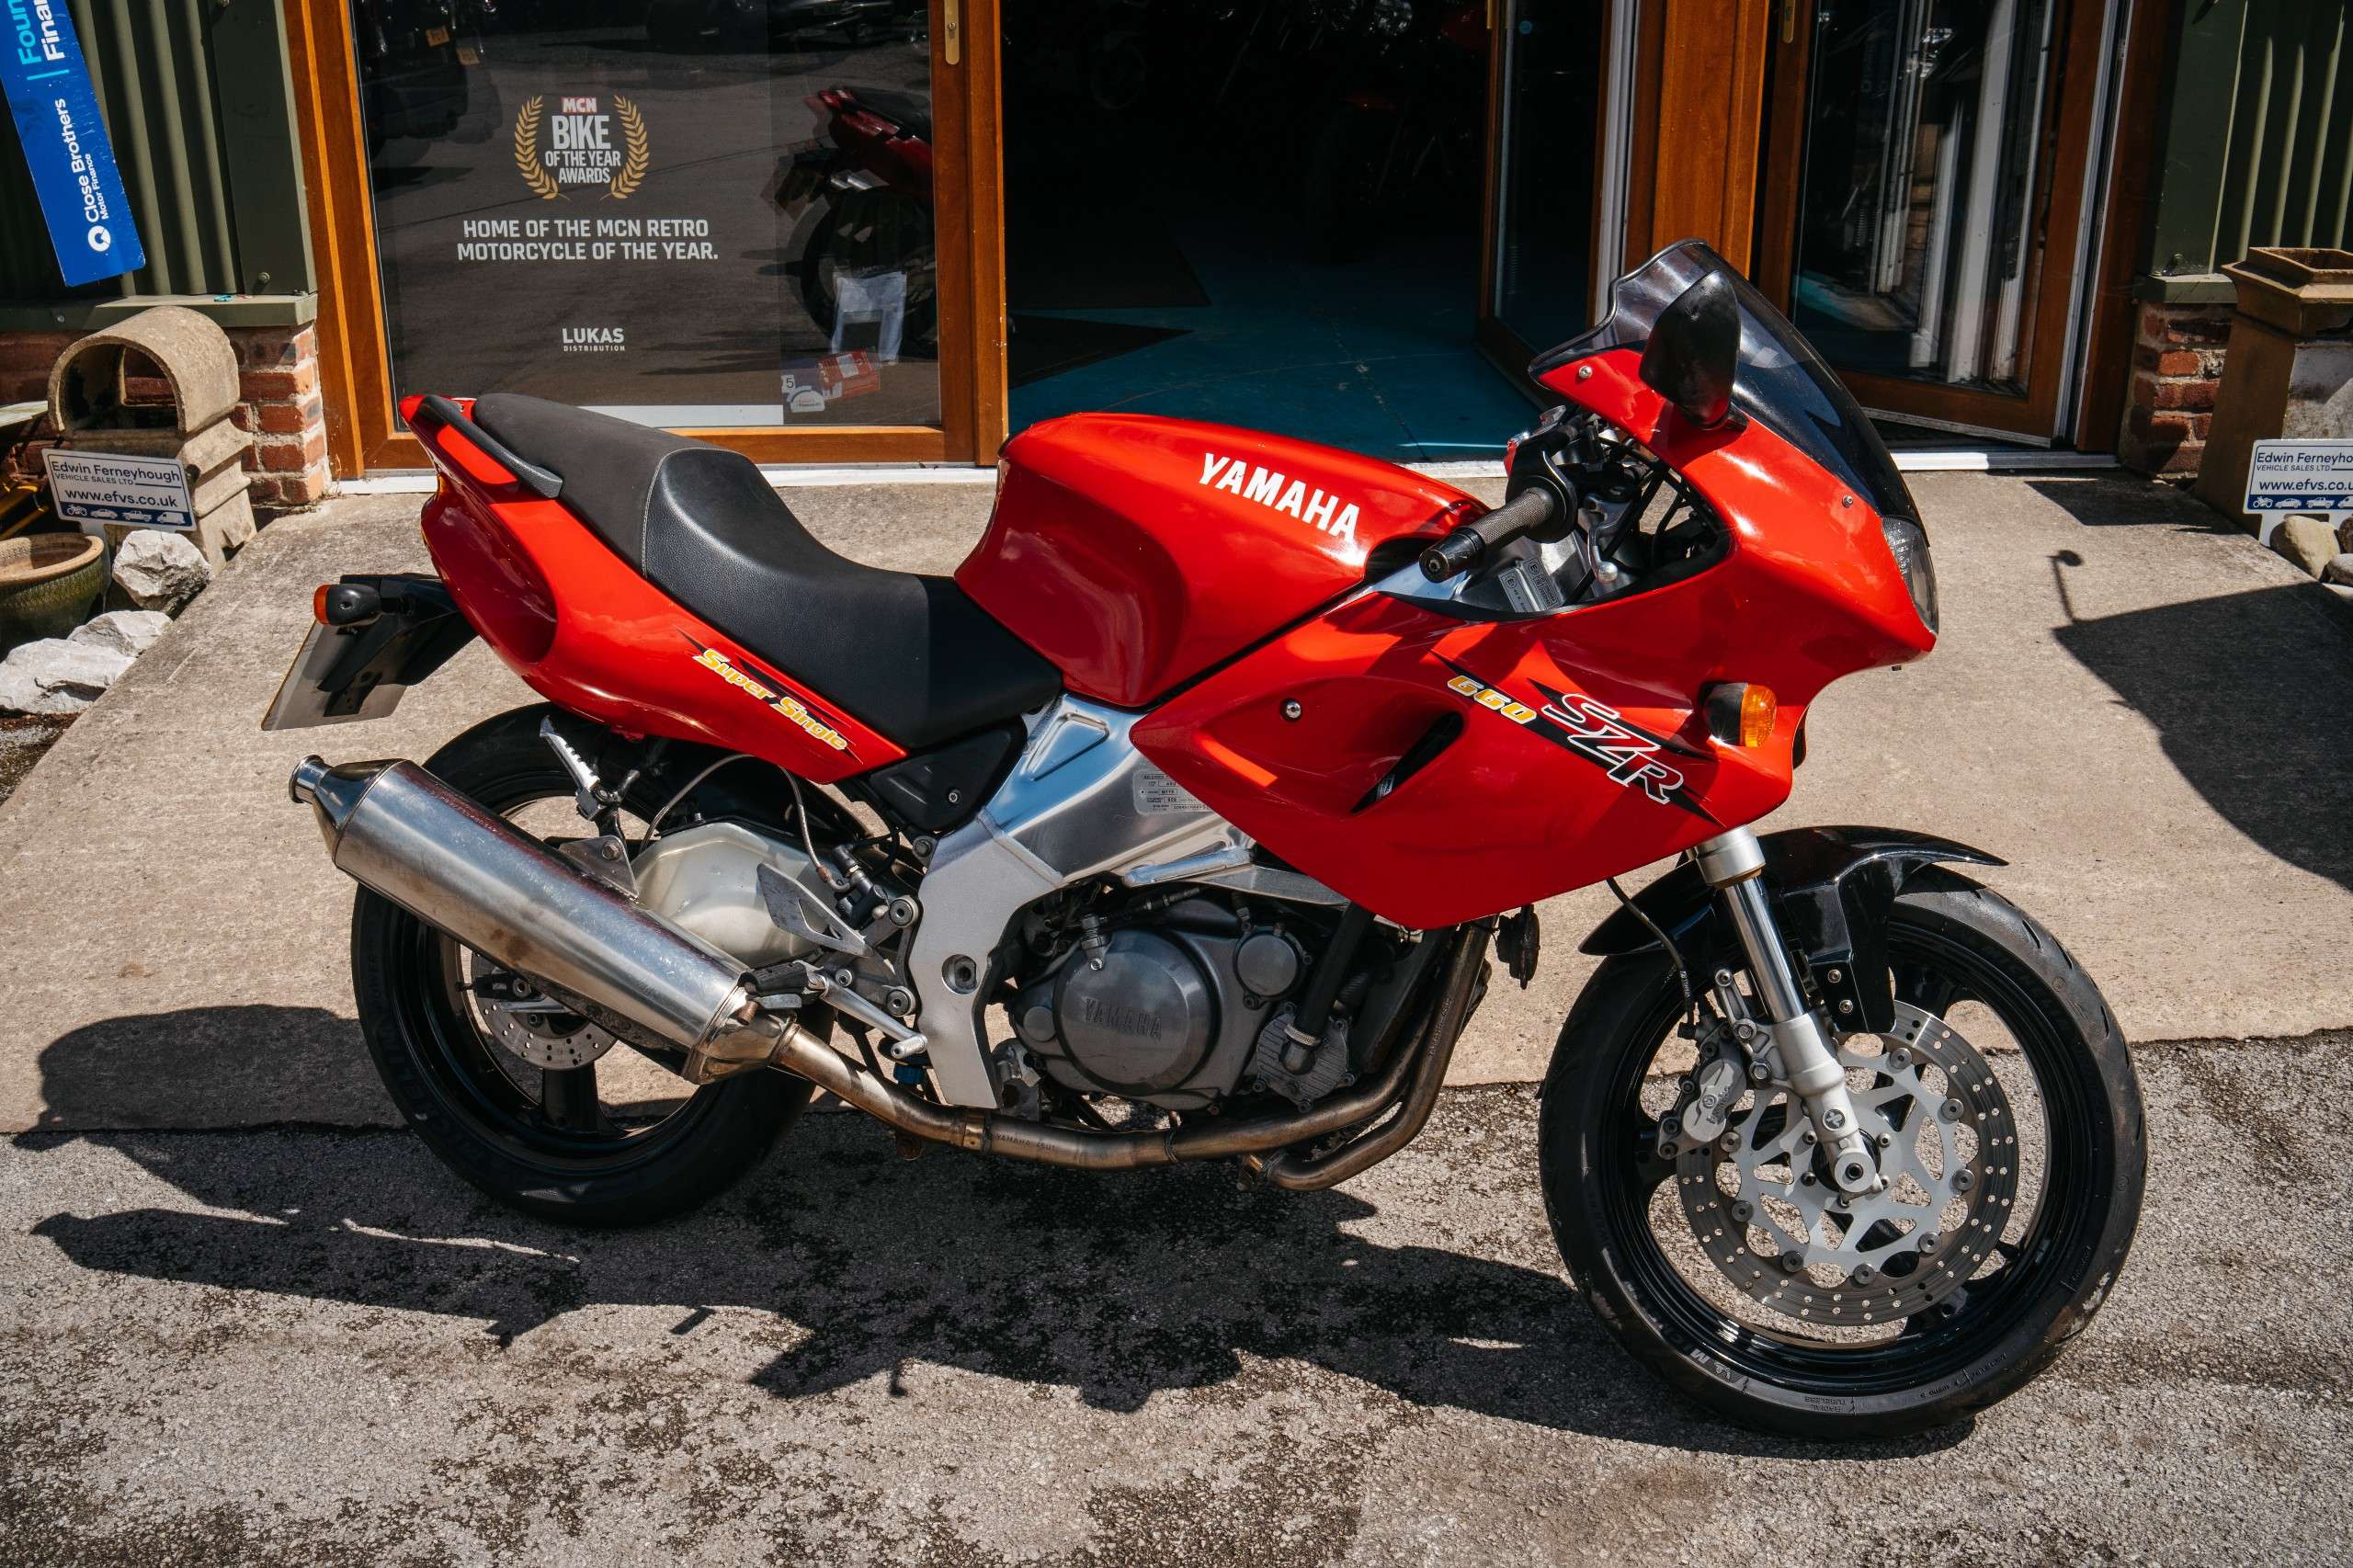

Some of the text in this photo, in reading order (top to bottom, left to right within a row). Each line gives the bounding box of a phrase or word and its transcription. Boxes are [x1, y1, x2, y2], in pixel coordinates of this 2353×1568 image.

[563, 97, 597, 112] MCN
[551, 115, 611, 150] BIKE
[54, 98, 99, 223] Close Brothers
[545, 151, 621, 166] OF THE YEAR
[558, 168, 611, 184] AWARDS
[85, 153, 109, 221] Motor Finance
[463, 219, 709, 238] HOME OF THE MCN RETRO
[457, 242, 719, 261] MOTORCYCLE OF THE YEAR.
[562, 327, 625, 344] LUKAS
[2256, 452, 2294, 463] Edwin
[51, 461, 180, 483] Edwin Ferneyhough
[54, 472, 135, 486] VEHICLE SALES LTD
[64, 489, 178, 507] www.efvs.co.uk
[1199, 453, 1360, 542] YAMAHA
[692, 648, 847, 750] Super Single
[1447, 675, 1537, 724] 660
[1540, 692, 1685, 805] SZR
[1086, 998, 1162, 1040] YAMAHA
